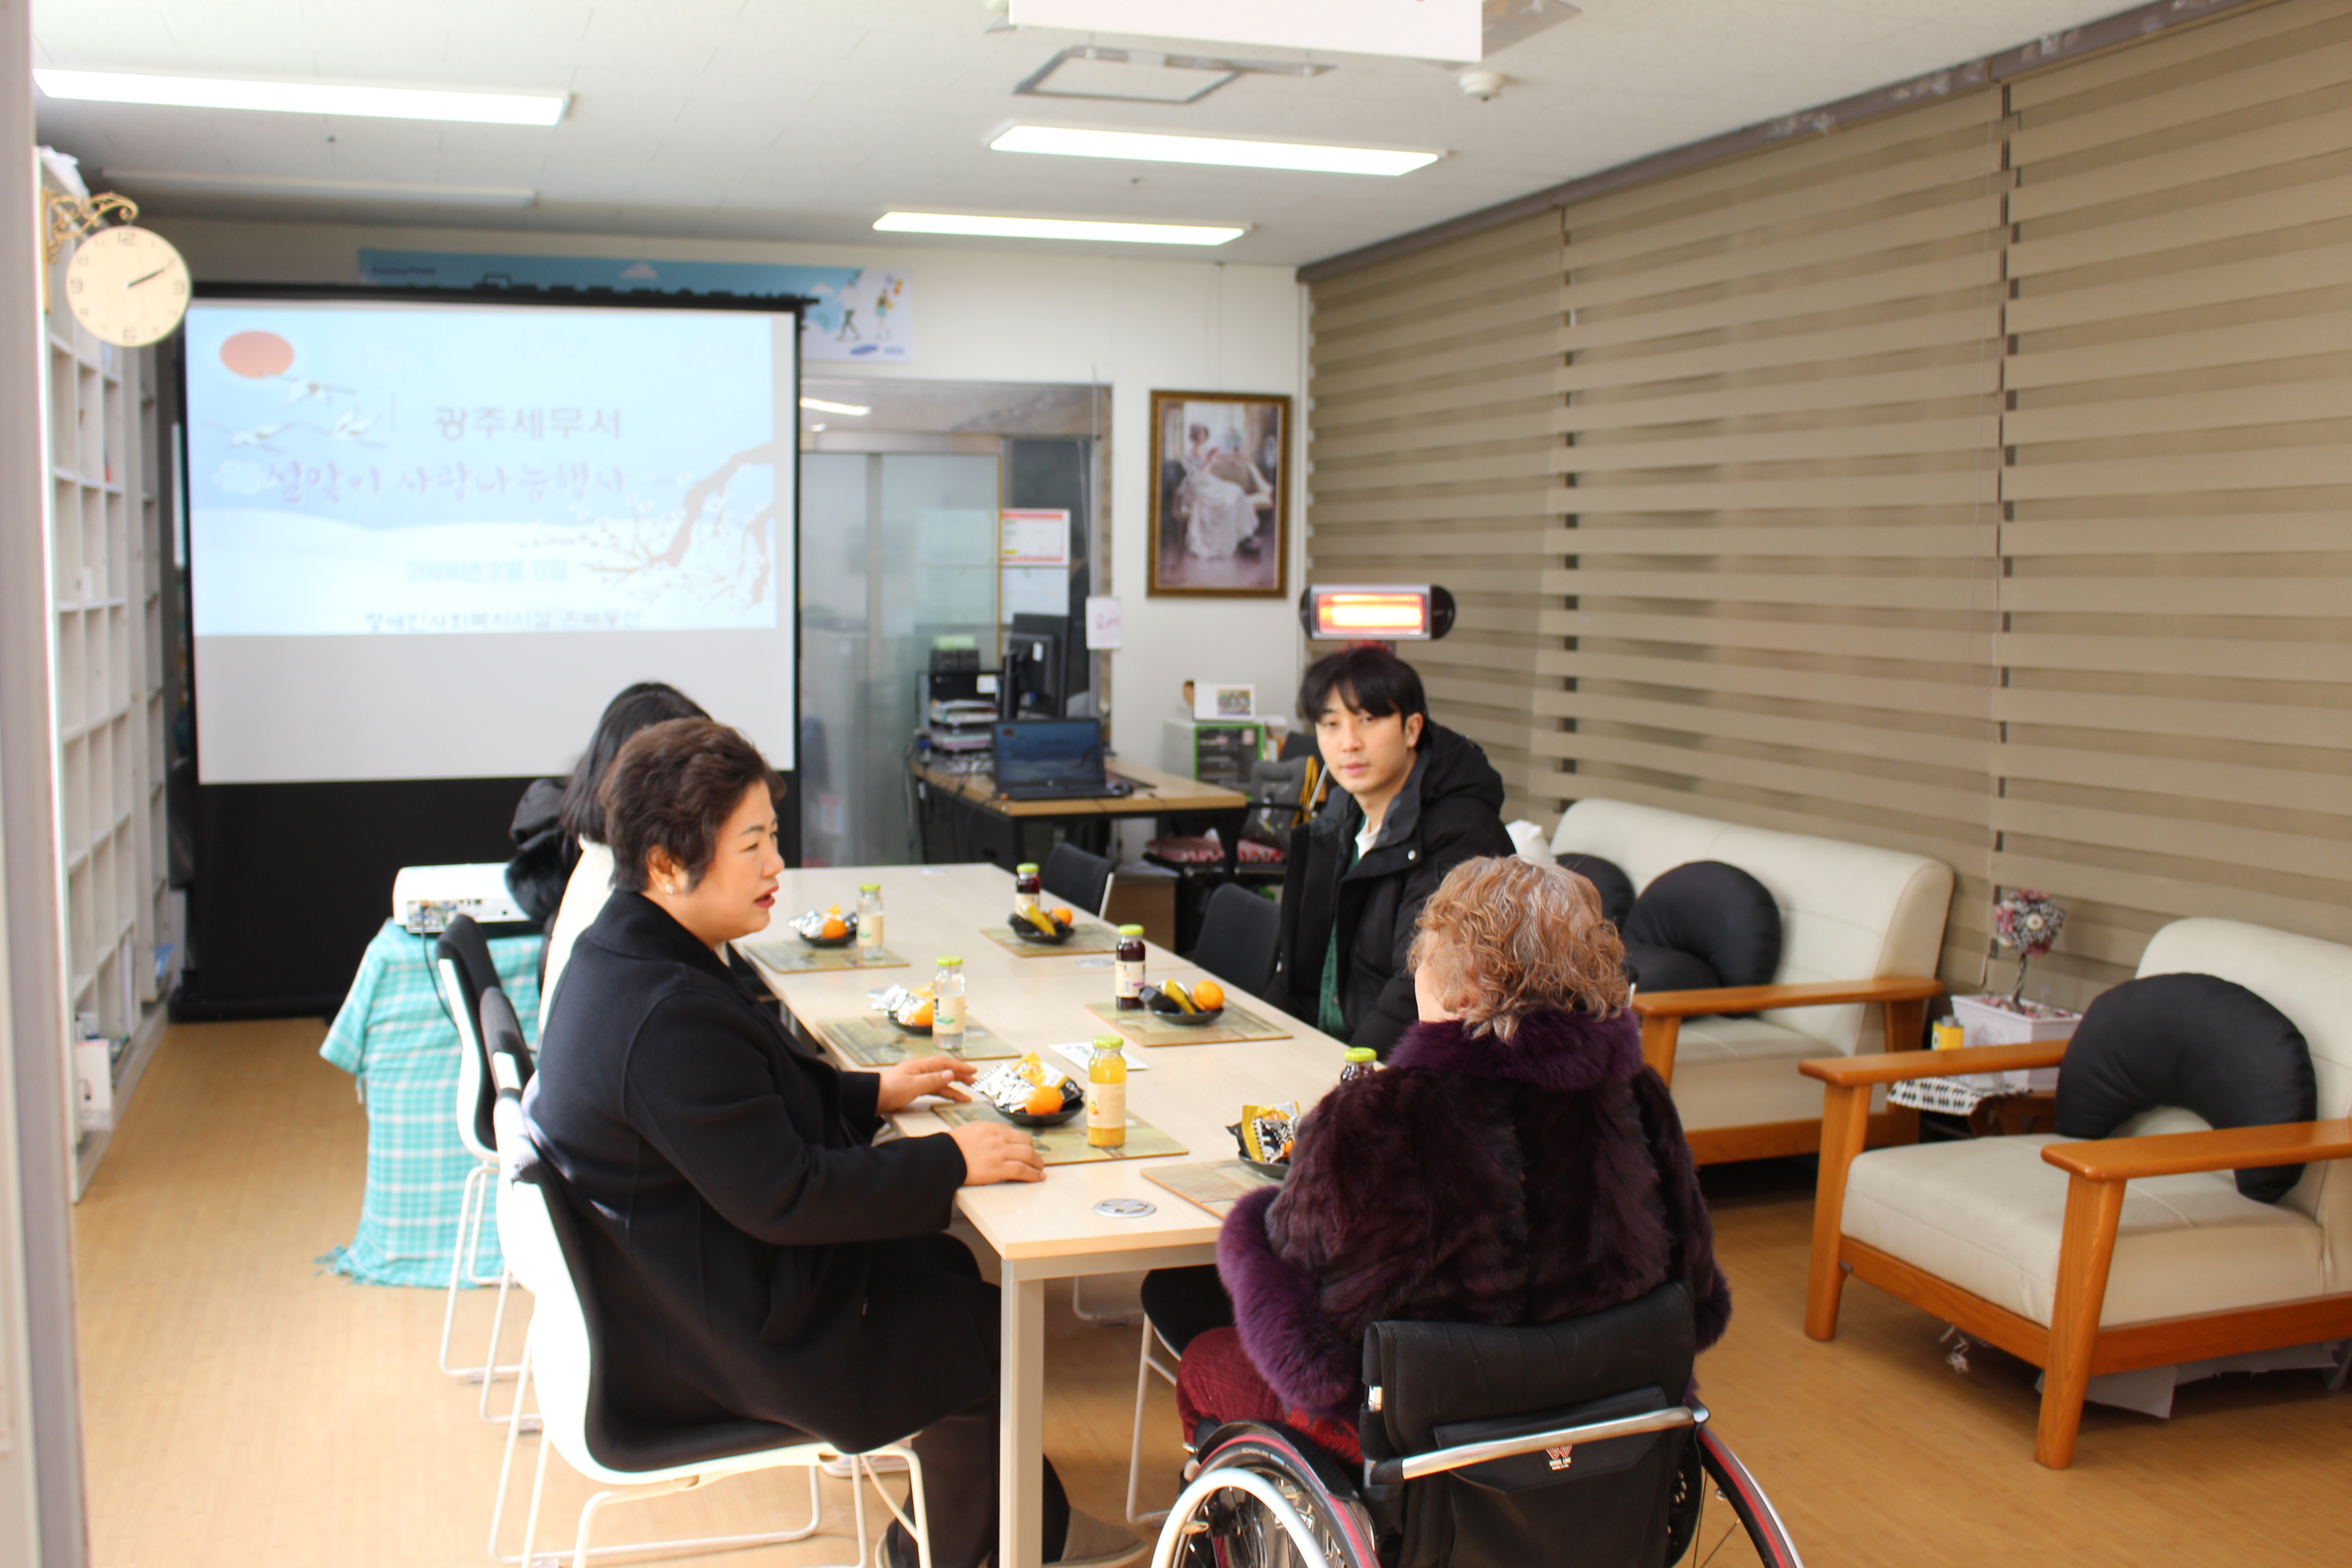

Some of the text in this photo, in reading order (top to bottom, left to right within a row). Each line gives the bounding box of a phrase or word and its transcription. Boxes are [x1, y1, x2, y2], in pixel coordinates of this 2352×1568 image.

[117, 230, 136, 246] 12
[69, 278, 83, 294] 9
[172, 279, 186, 296] 3
[122, 326, 136, 343] 6
[434, 407, 623, 441] 광주세무서
[266, 459, 381, 504] 설맞이
